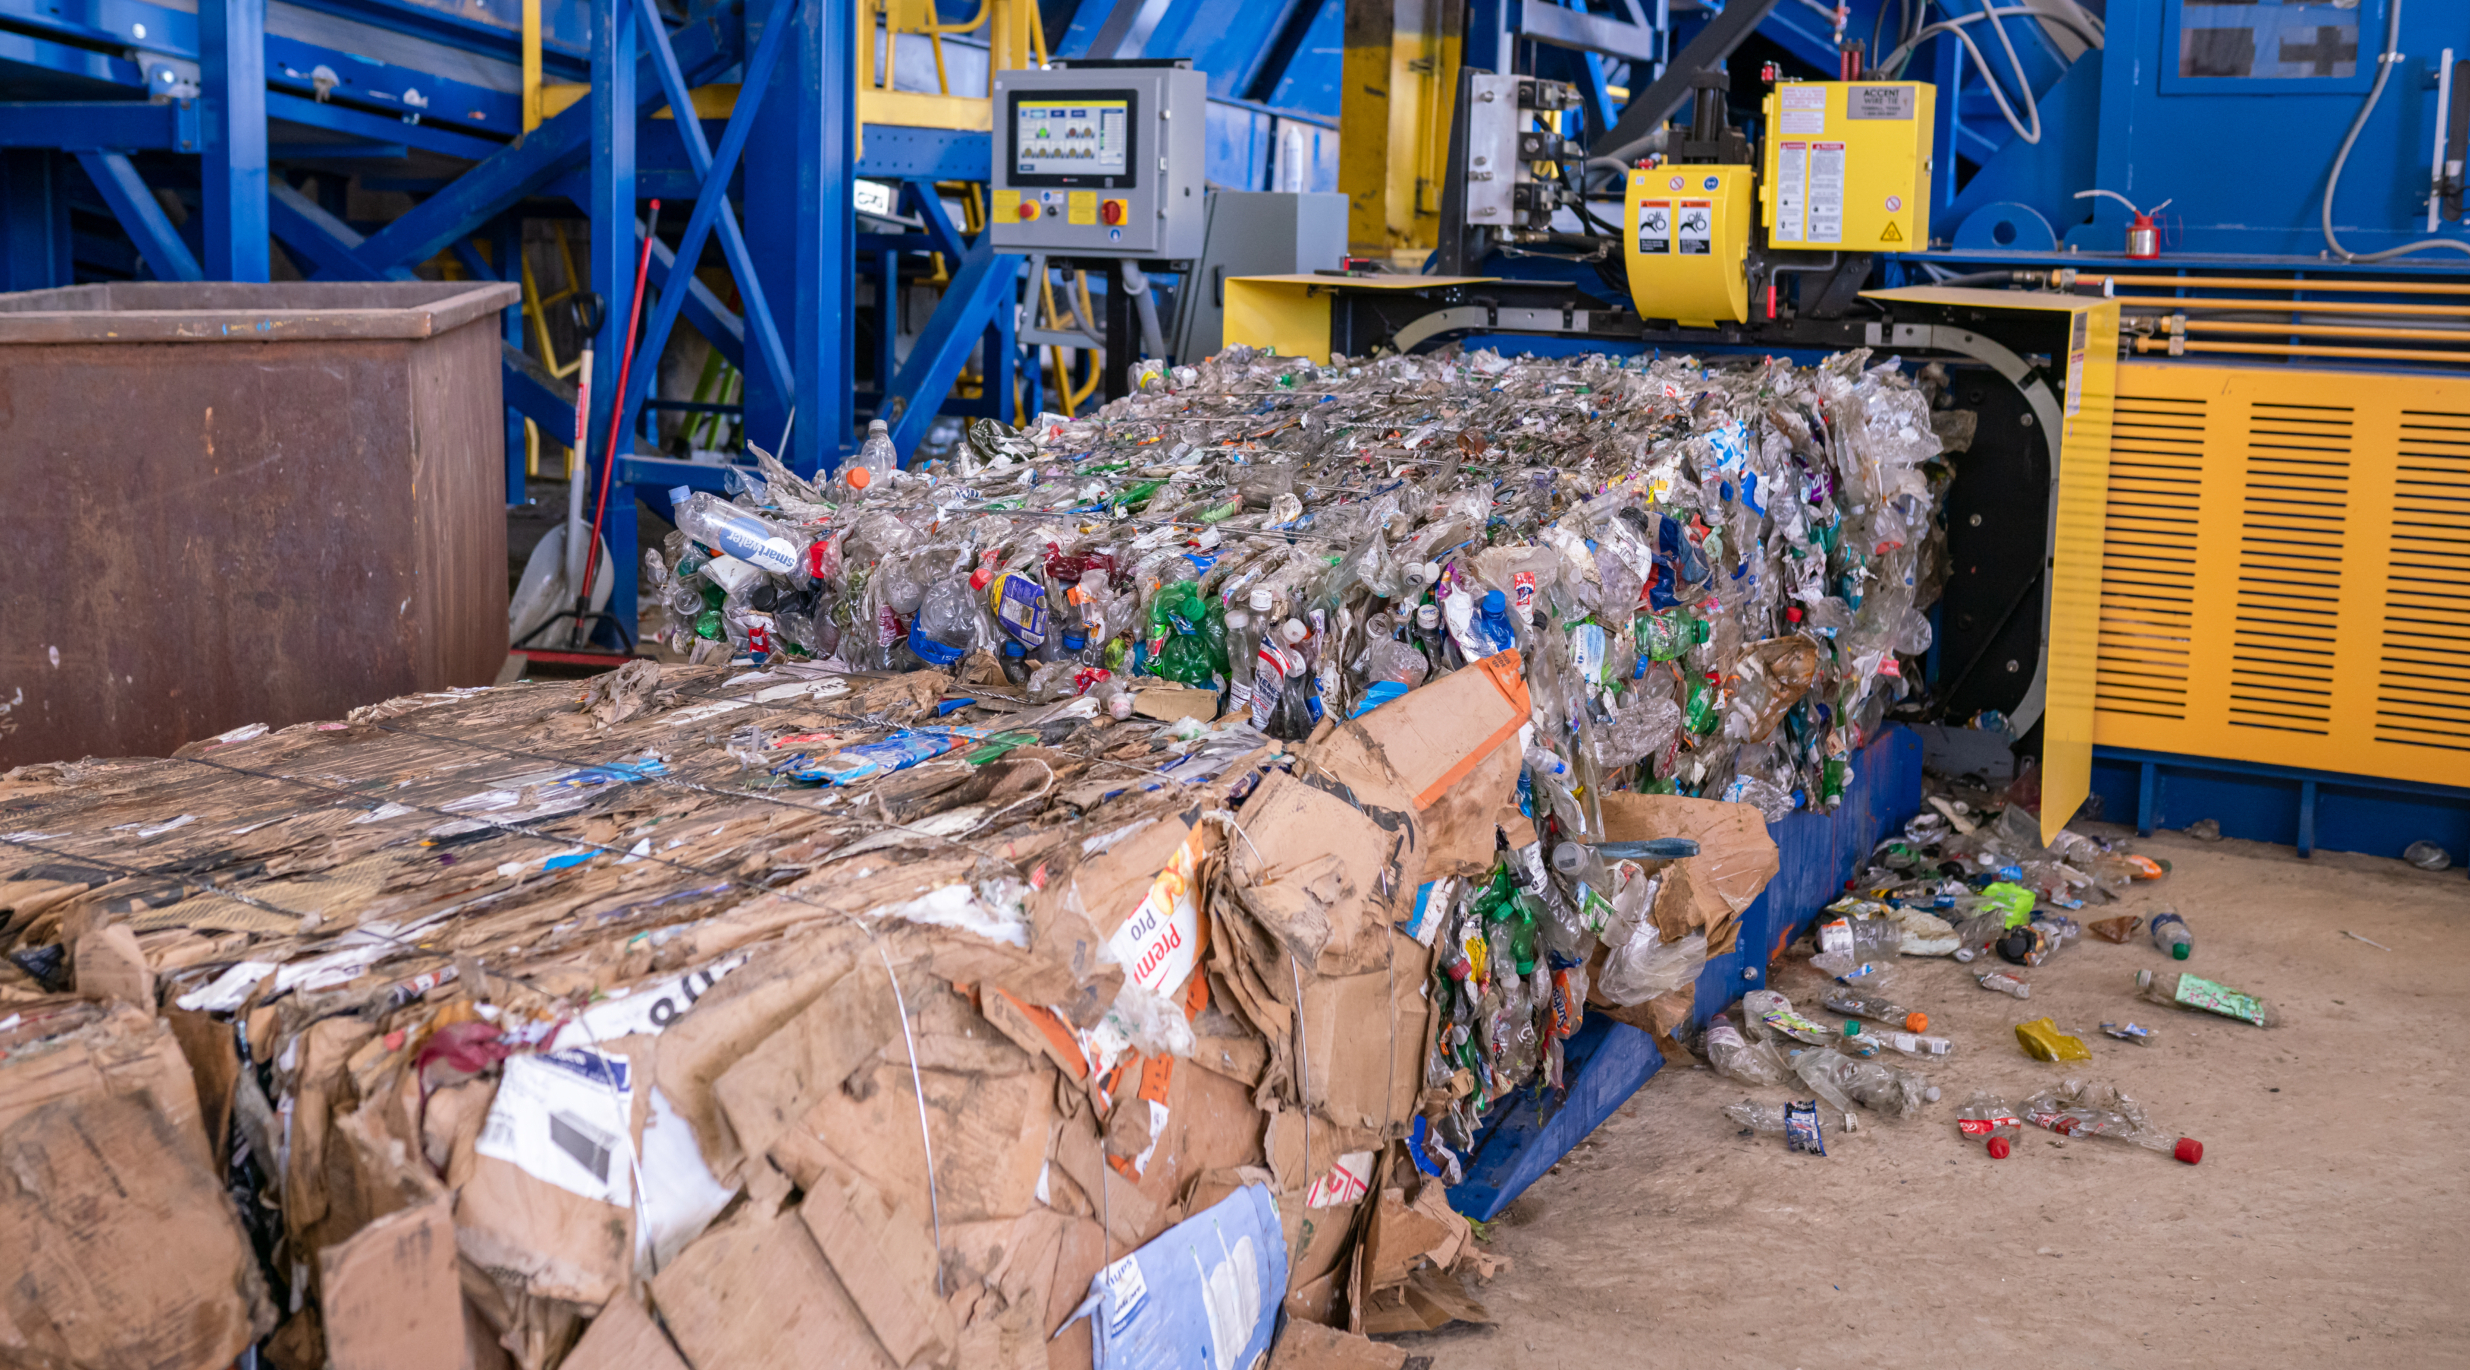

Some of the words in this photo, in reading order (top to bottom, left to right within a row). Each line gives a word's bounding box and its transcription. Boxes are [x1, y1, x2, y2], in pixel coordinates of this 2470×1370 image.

[1864, 89, 1899, 97] ACCENT
[727, 531, 795, 567] smartwater
[1131, 908, 1156, 941] Pro
